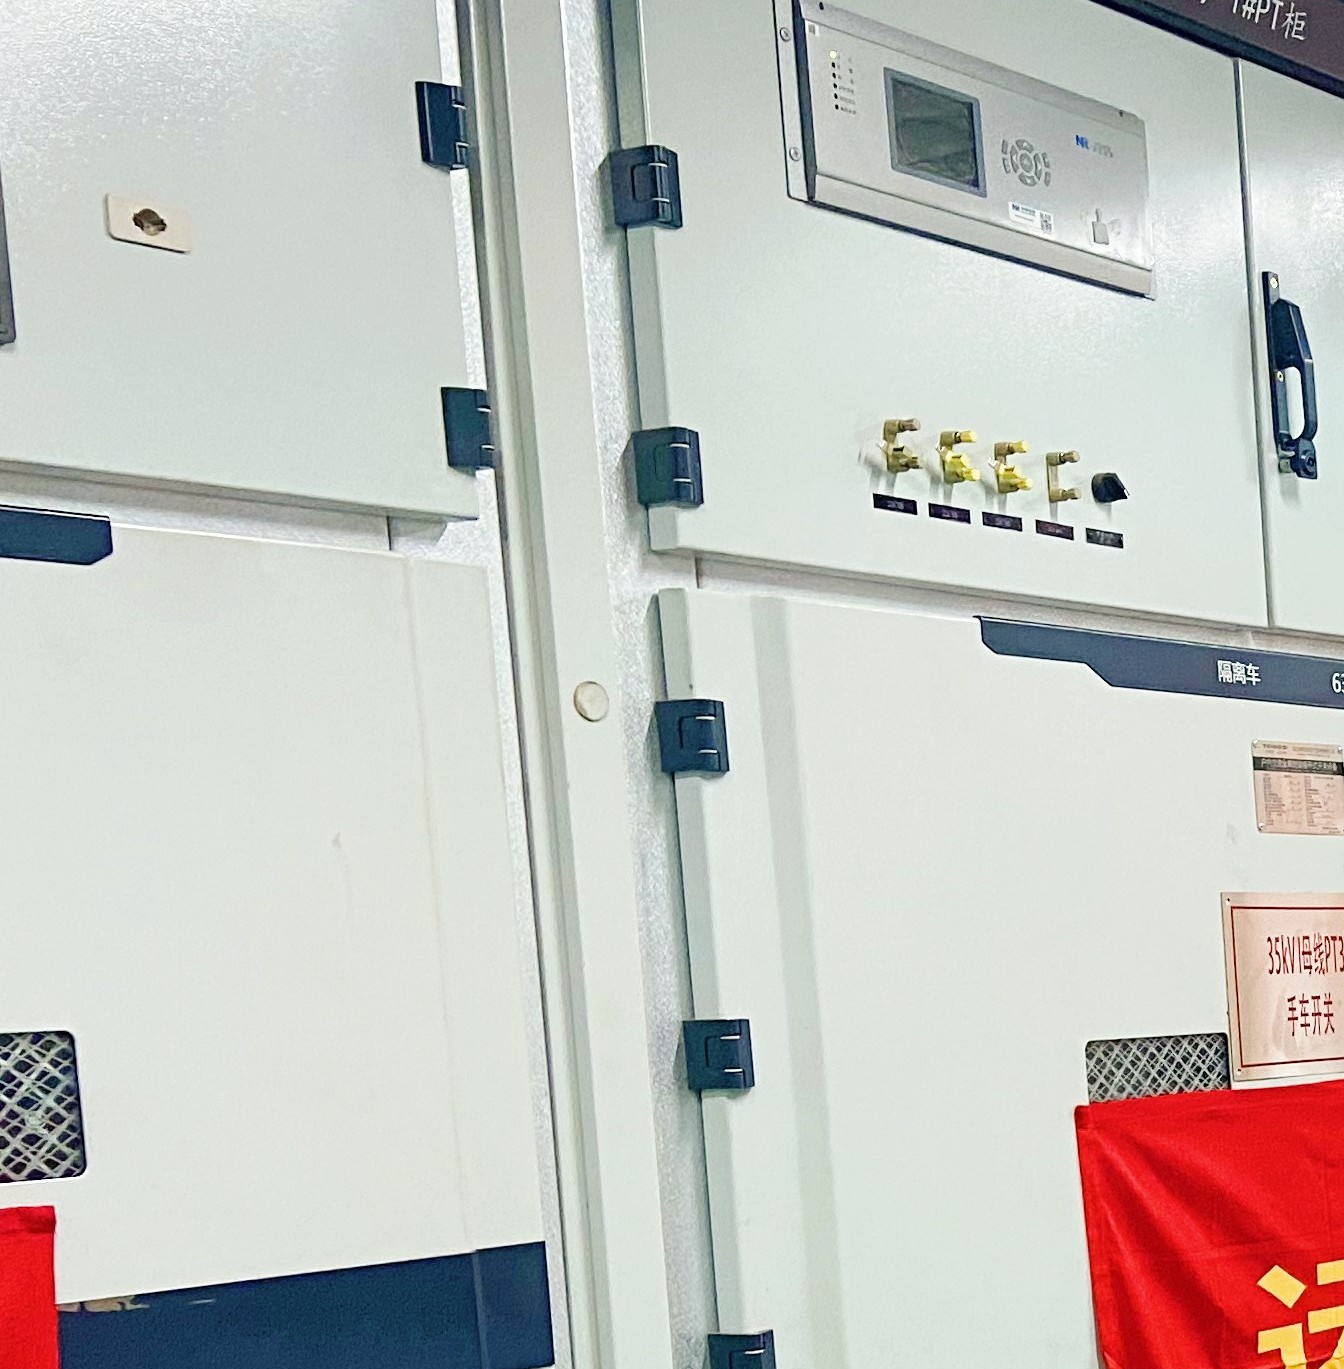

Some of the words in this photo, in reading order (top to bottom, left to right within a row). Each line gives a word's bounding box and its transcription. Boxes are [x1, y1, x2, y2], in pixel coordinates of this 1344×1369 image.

[1217, 659, 1261, 686] 隔离车
[1286, 991, 1335, 1037] 手车开关
